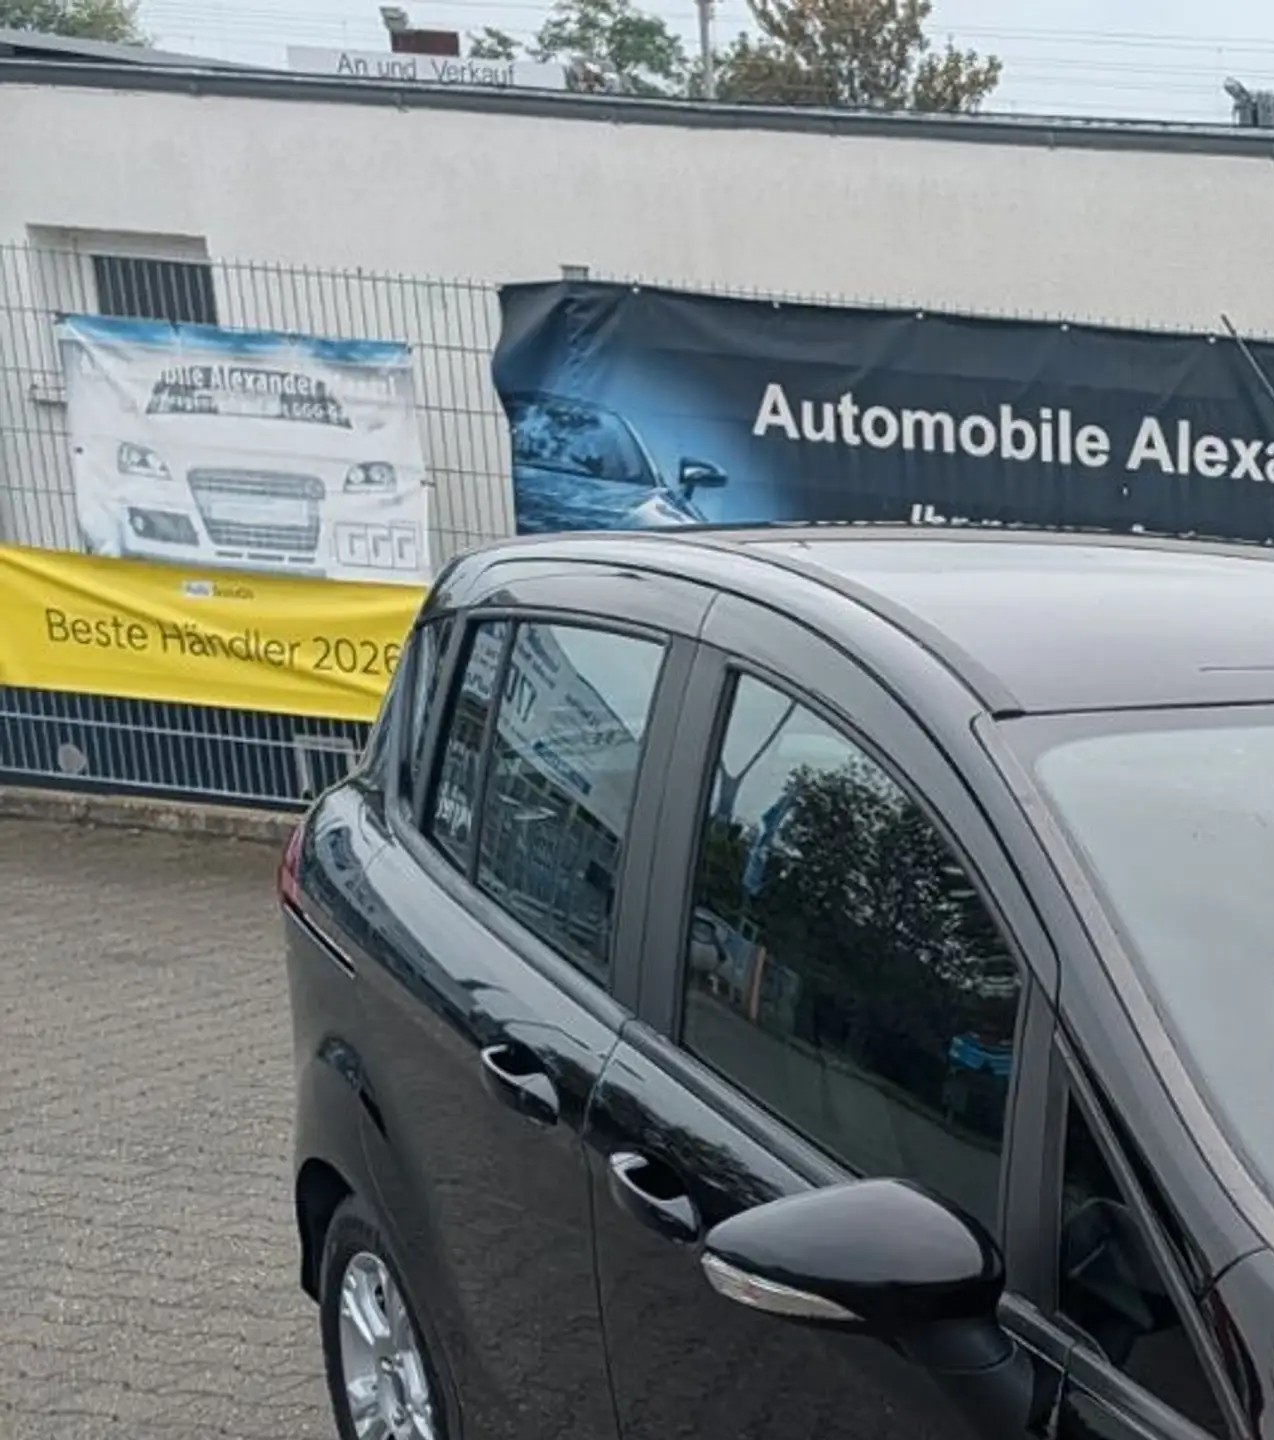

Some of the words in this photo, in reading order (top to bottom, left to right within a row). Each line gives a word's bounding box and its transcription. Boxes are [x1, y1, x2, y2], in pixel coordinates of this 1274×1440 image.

[338, 53, 368, 76] An
[377, 57, 417, 82] und
[431, 58, 515, 87] Verkauf
[209, 363, 320, 397] Alexander
[752, 382, 1111, 468] Automobile
[45, 606, 149, 651] Beste
[157, 619, 301, 670] Händler
